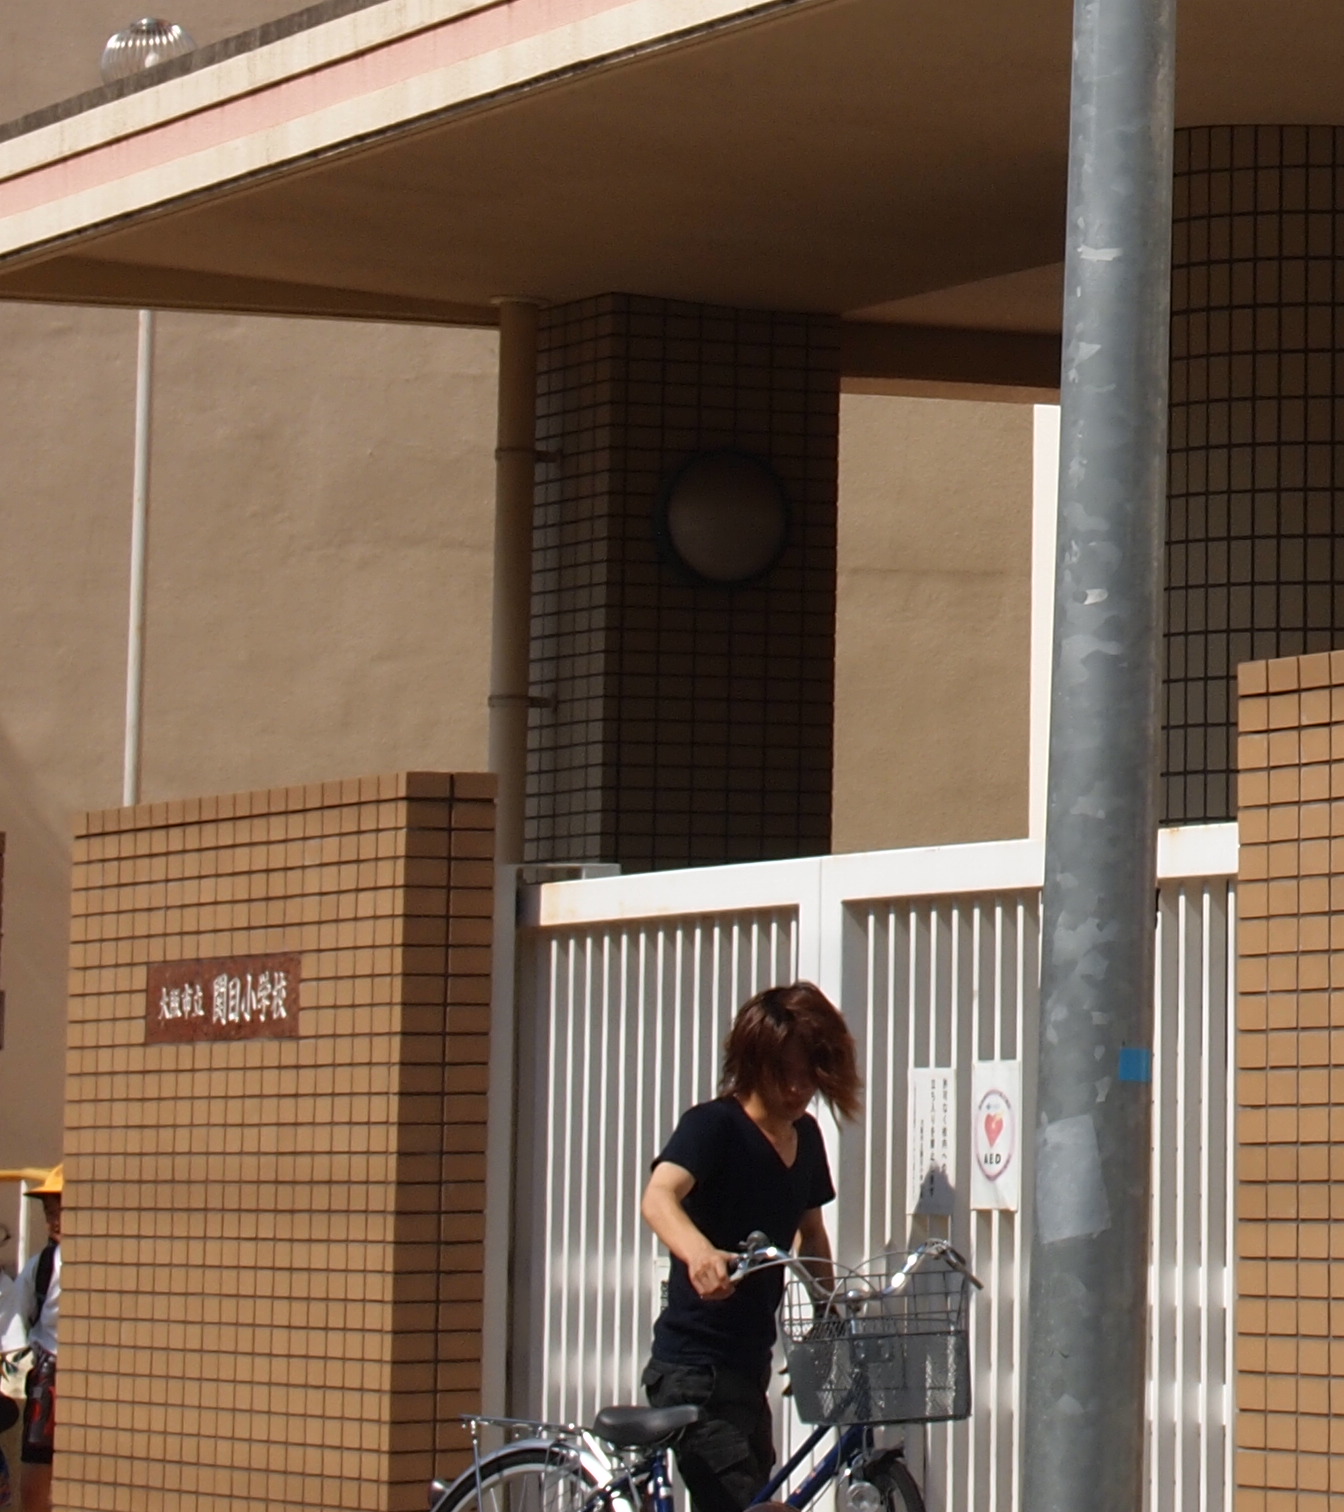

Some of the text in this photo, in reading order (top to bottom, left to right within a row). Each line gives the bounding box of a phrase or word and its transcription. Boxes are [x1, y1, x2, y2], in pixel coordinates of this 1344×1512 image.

[213, 971, 287, 1025] 関目小学校
[984, 1153, 1002, 1165] AED
